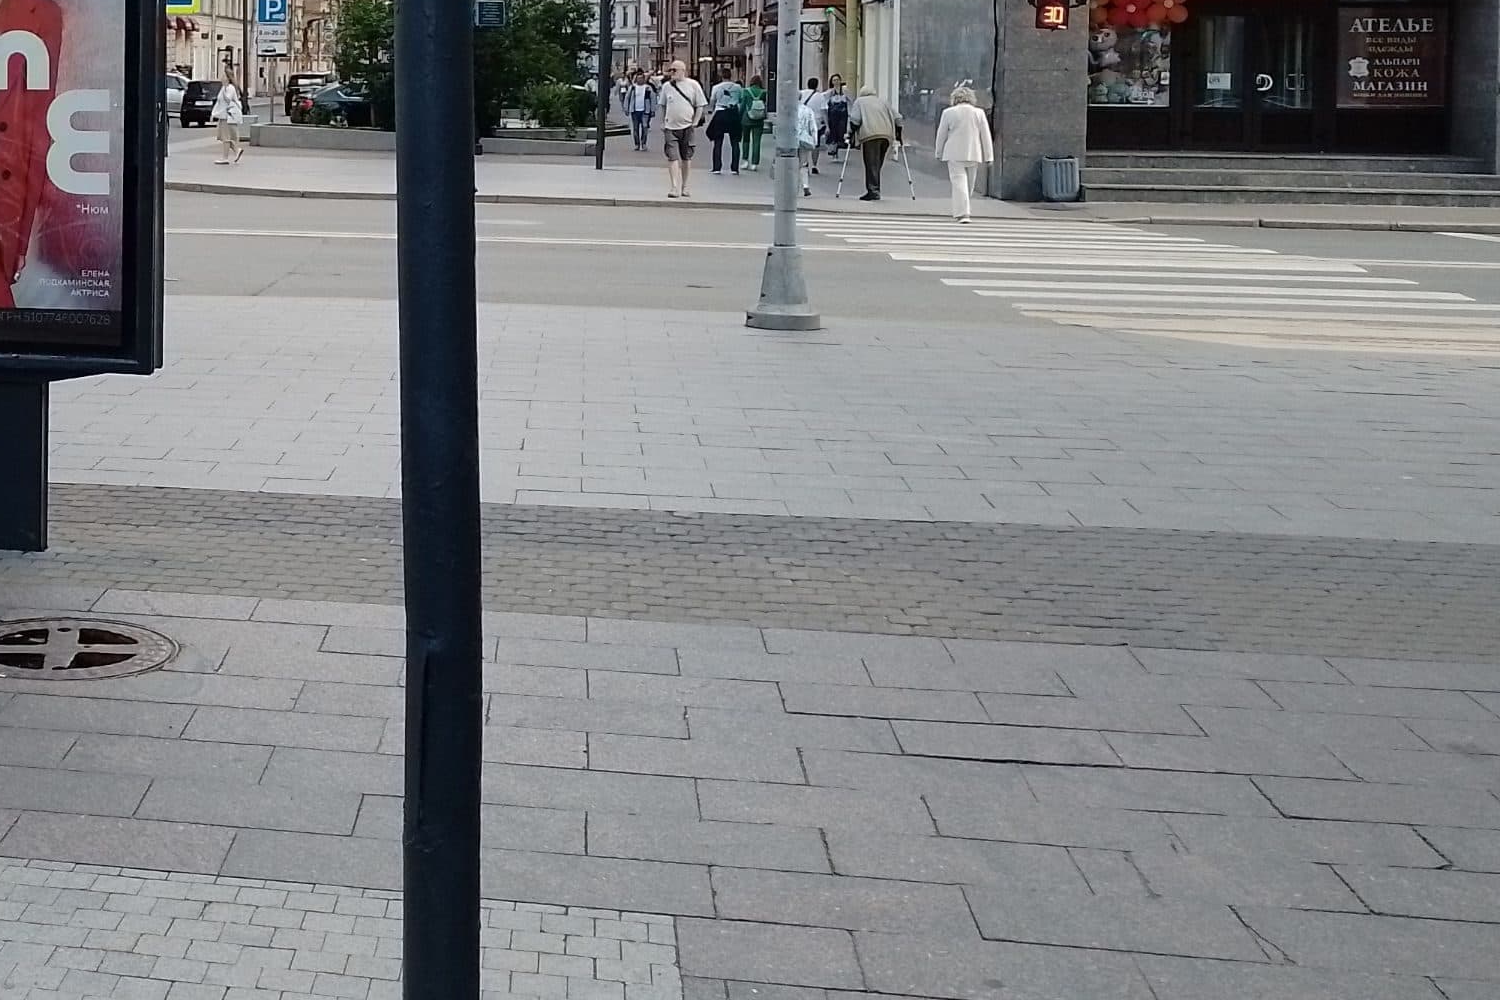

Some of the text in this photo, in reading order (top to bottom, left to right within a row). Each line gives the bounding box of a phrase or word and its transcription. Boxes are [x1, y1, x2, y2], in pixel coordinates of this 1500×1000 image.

[1043, 6, 1063, 23] 30
[1349, 18, 1434, 33] АТЕЛЬЕ
[1373, 69, 1420, 78] КОЖА
[1353, 81, 1428, 92] МАГАЗИН
[81, 269, 110, 277] ЕЛЕНА
[70, 288, 110, 297] АКТРИСА
